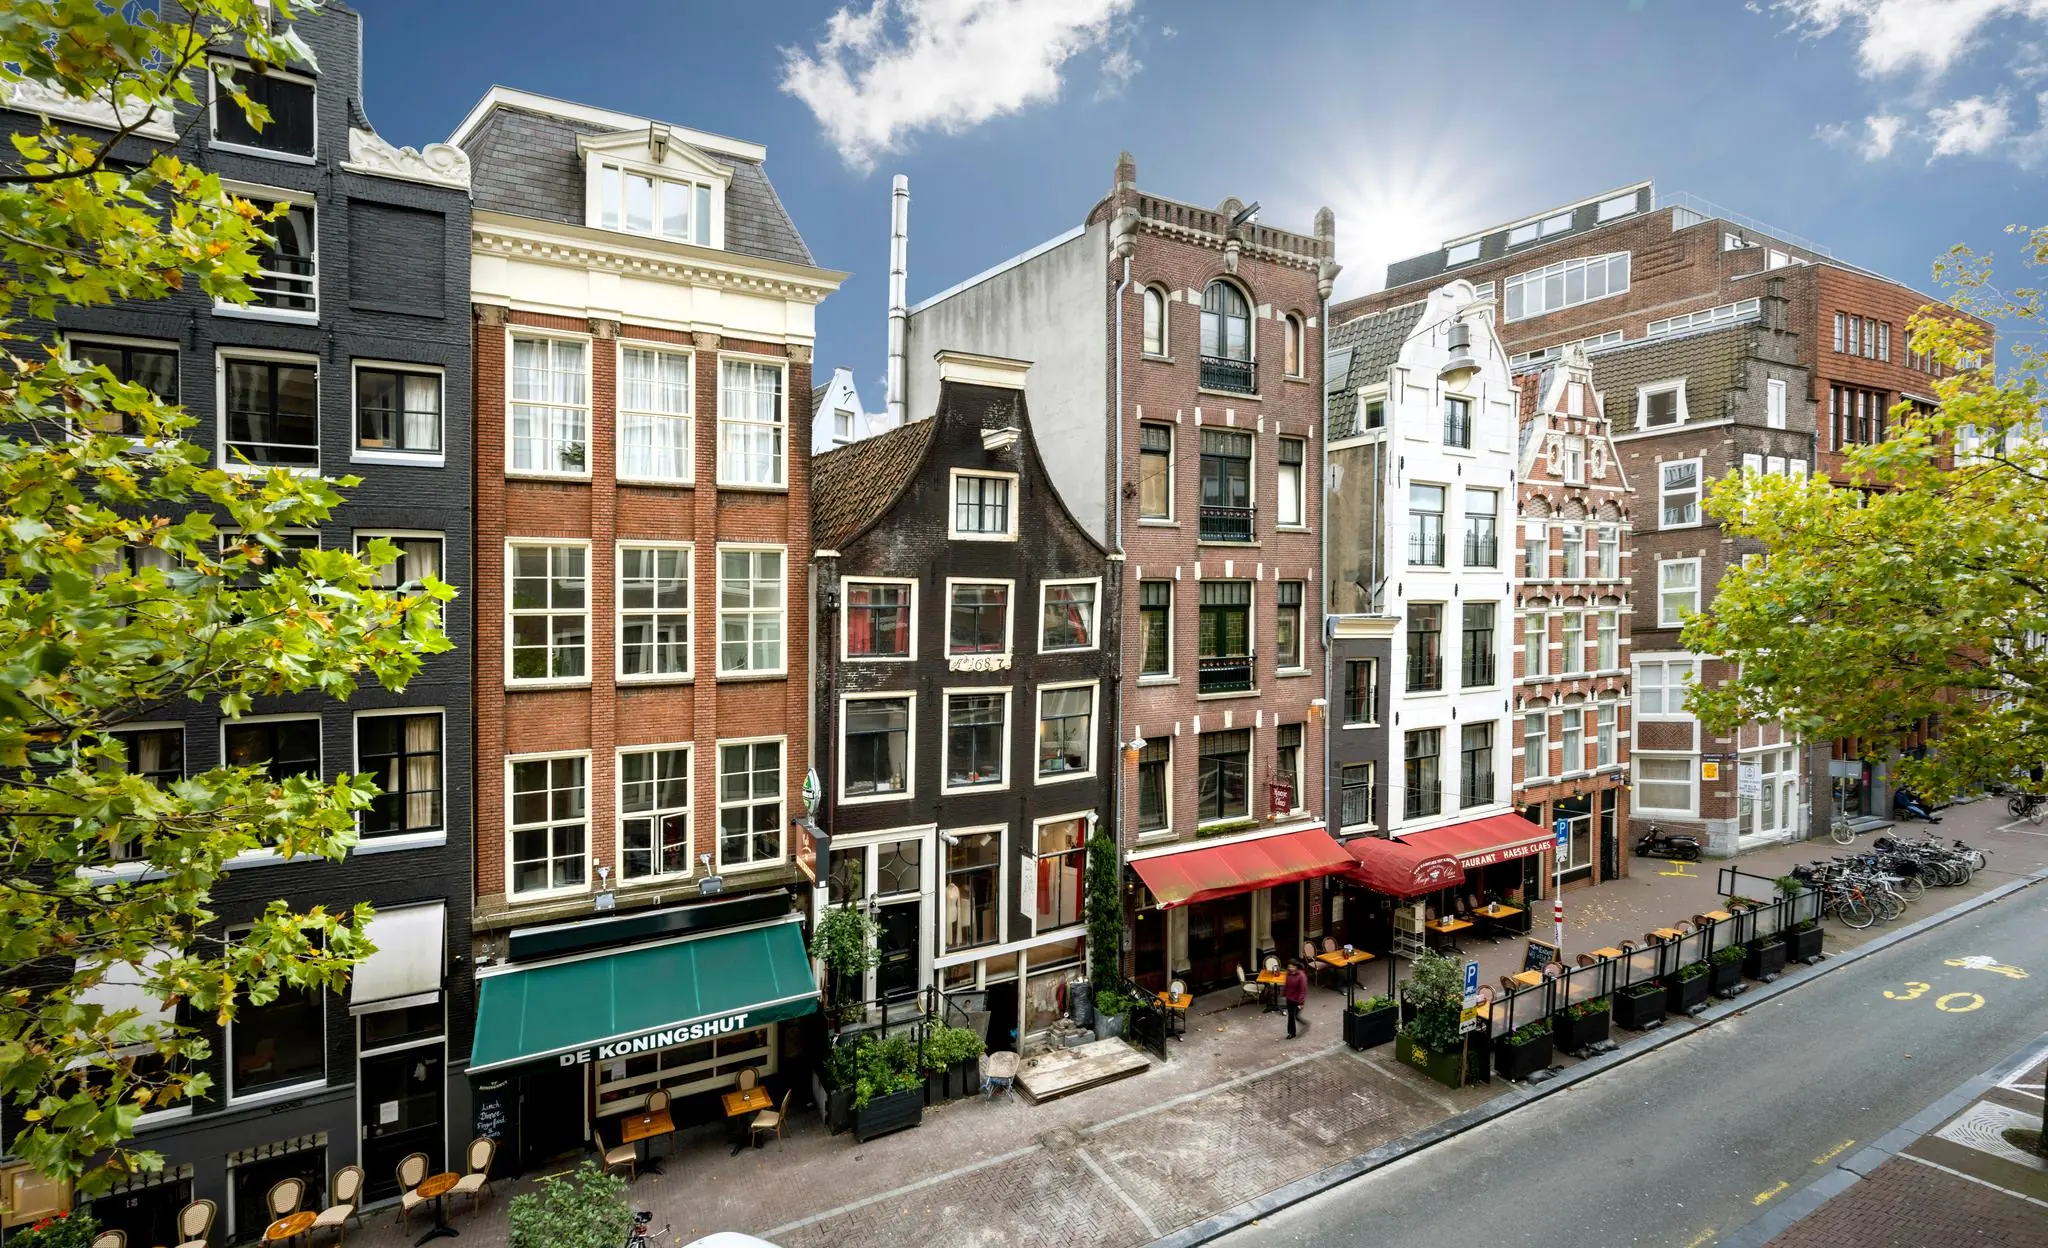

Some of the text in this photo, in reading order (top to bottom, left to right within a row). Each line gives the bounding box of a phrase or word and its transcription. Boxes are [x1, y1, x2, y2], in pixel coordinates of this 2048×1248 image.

[1560, 822, 1565, 834] P
[1503, 846, 1529, 859] HAESJE
[1530, 841, 1551, 853] CLAES
[1468, 965, 1476, 983] P
[560, 1013, 749, 1067] DE KONINGSHUT
